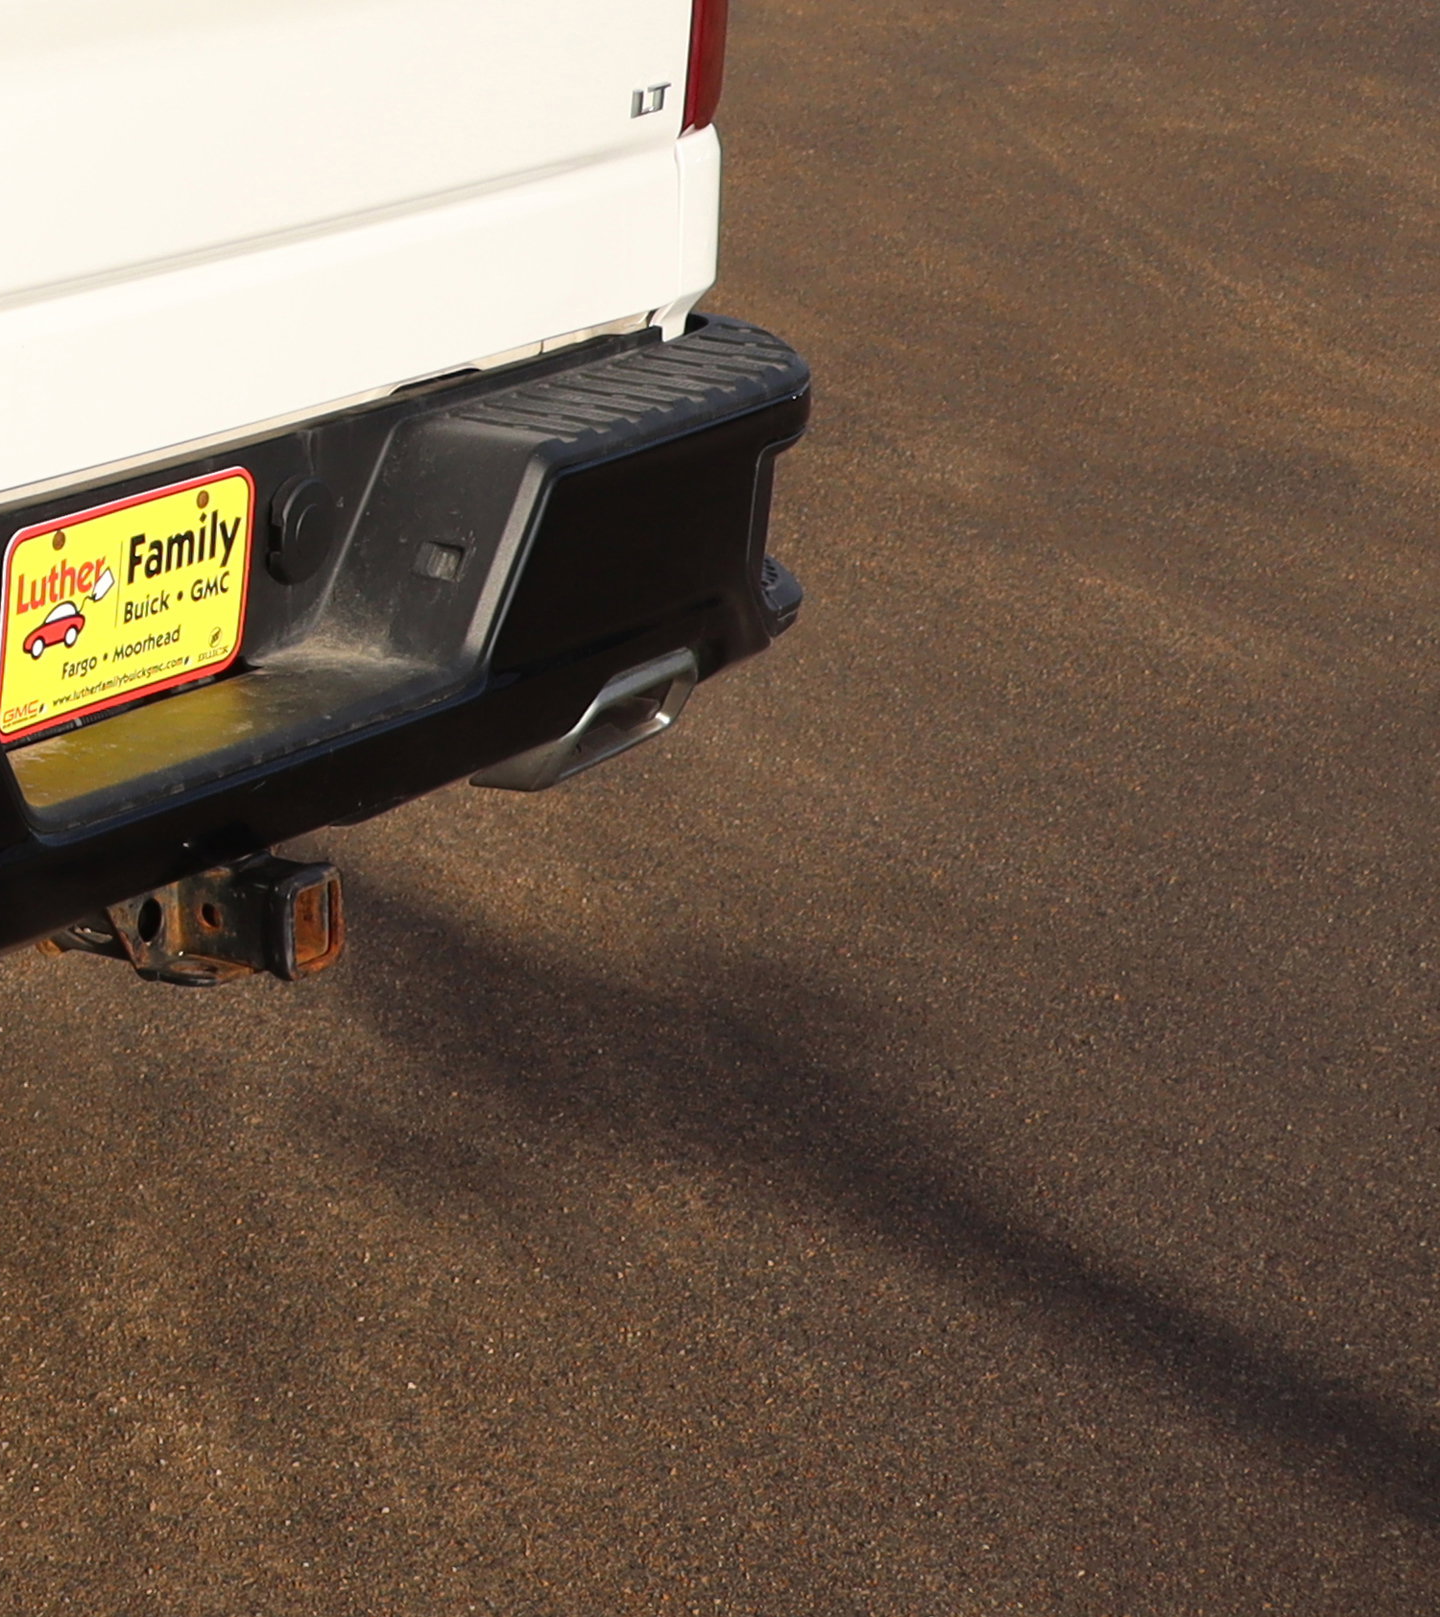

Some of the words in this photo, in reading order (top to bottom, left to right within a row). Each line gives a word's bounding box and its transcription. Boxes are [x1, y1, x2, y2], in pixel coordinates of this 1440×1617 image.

[630, 81, 672, 119] LT
[16, 555, 107, 615] Luther
[127, 510, 241, 586] Family
[123, 590, 170, 624] Buick
[190, 571, 230, 602] GMC
[61, 656, 97, 680] Fargo
[112, 625, 181, 663] Moorhead
[3, 699, 39, 724] GMC
